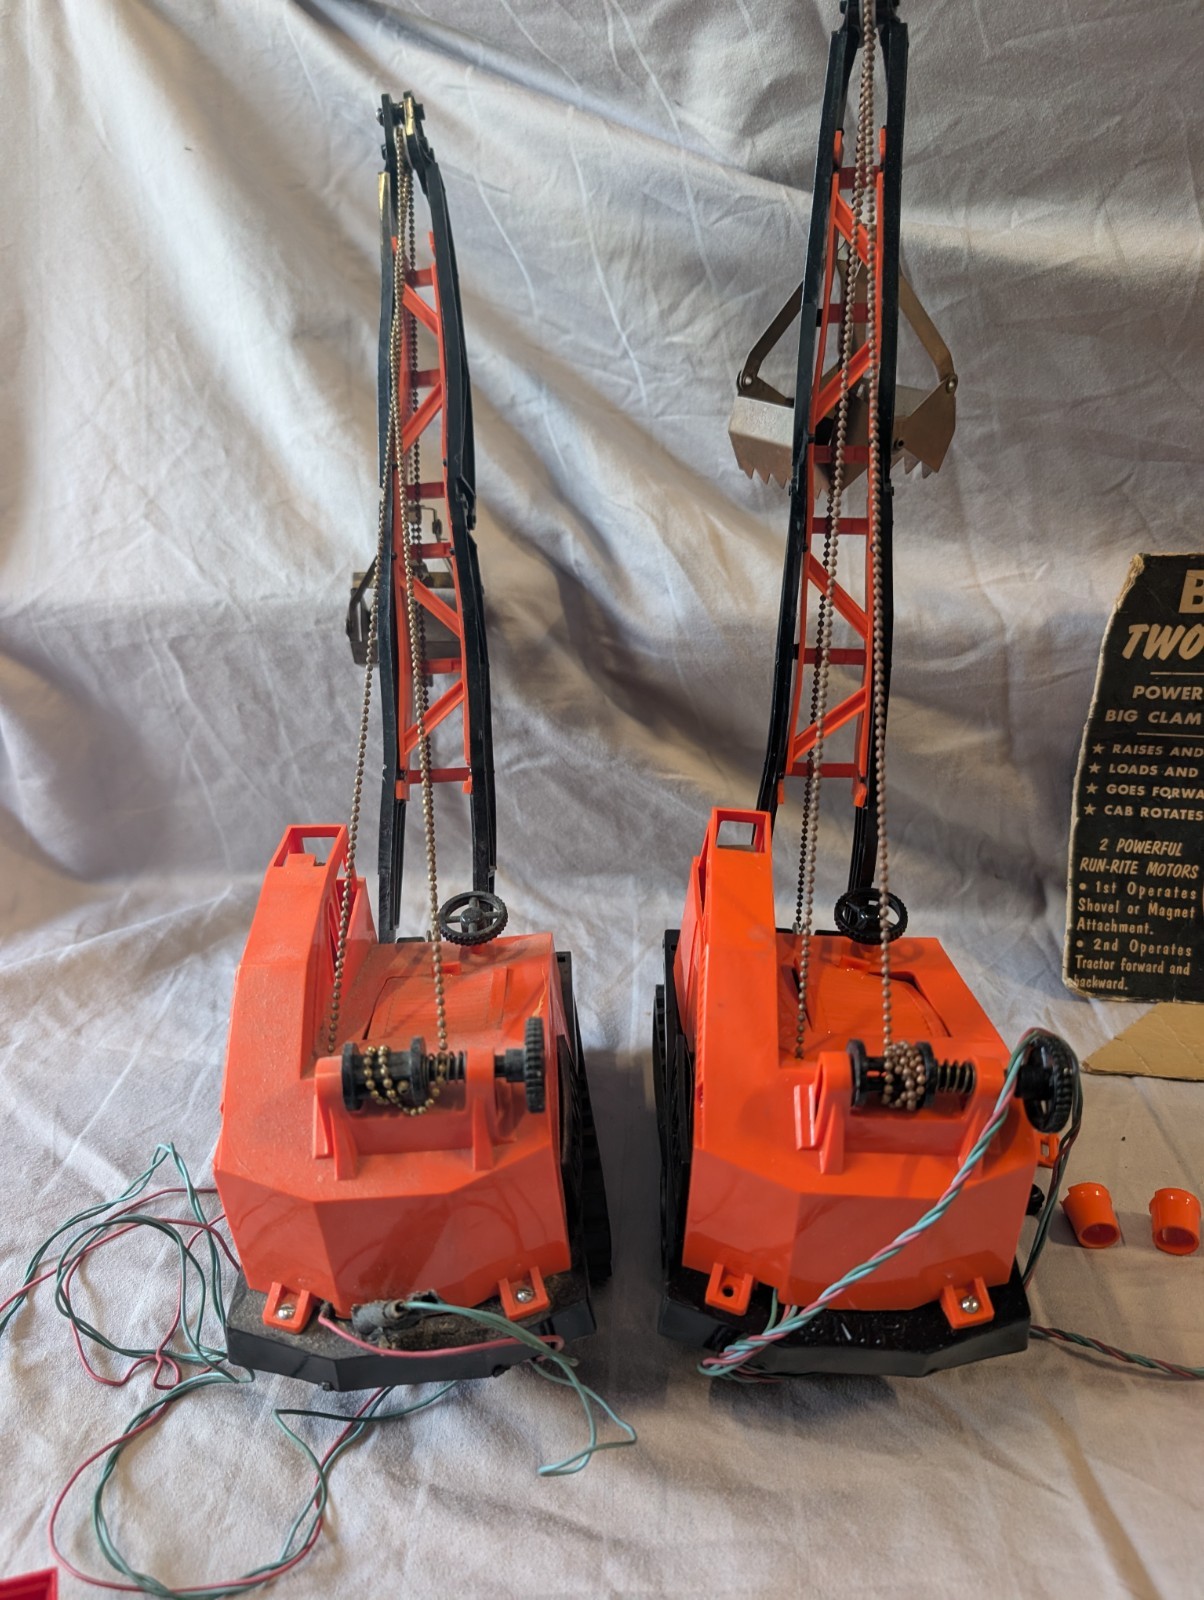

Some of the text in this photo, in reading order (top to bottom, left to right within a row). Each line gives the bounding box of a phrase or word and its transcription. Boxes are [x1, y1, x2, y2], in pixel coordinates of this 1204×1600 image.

[1122, 623, 1204, 661] TWO
[1132, 685, 1203, 700] POWER
[1105, 709, 1202, 726] BIG CLAM
[1112, 744, 1204, 757] RAISES AND
[1108, 763, 1198, 778] LOADS AND
[1106, 784, 1204, 800] GOES FORWA
[1104, 805, 1204, 821] CAB ROTATES
[1099, 838, 1183, 857] 2 POWERFUL
[1080, 857, 1200, 879] RUN-RITE MOTORS
[1096, 881, 1197, 900] 1st Operates
[1078, 897, 1196, 921] Shovel or Magnet
[1076, 917, 1154, 935] Attachment.
[1093, 938, 1192, 957] 2nd Operates
[1075, 955, 1190, 976] Tractor forward and
[1073, 974, 1128, 990] backward.
